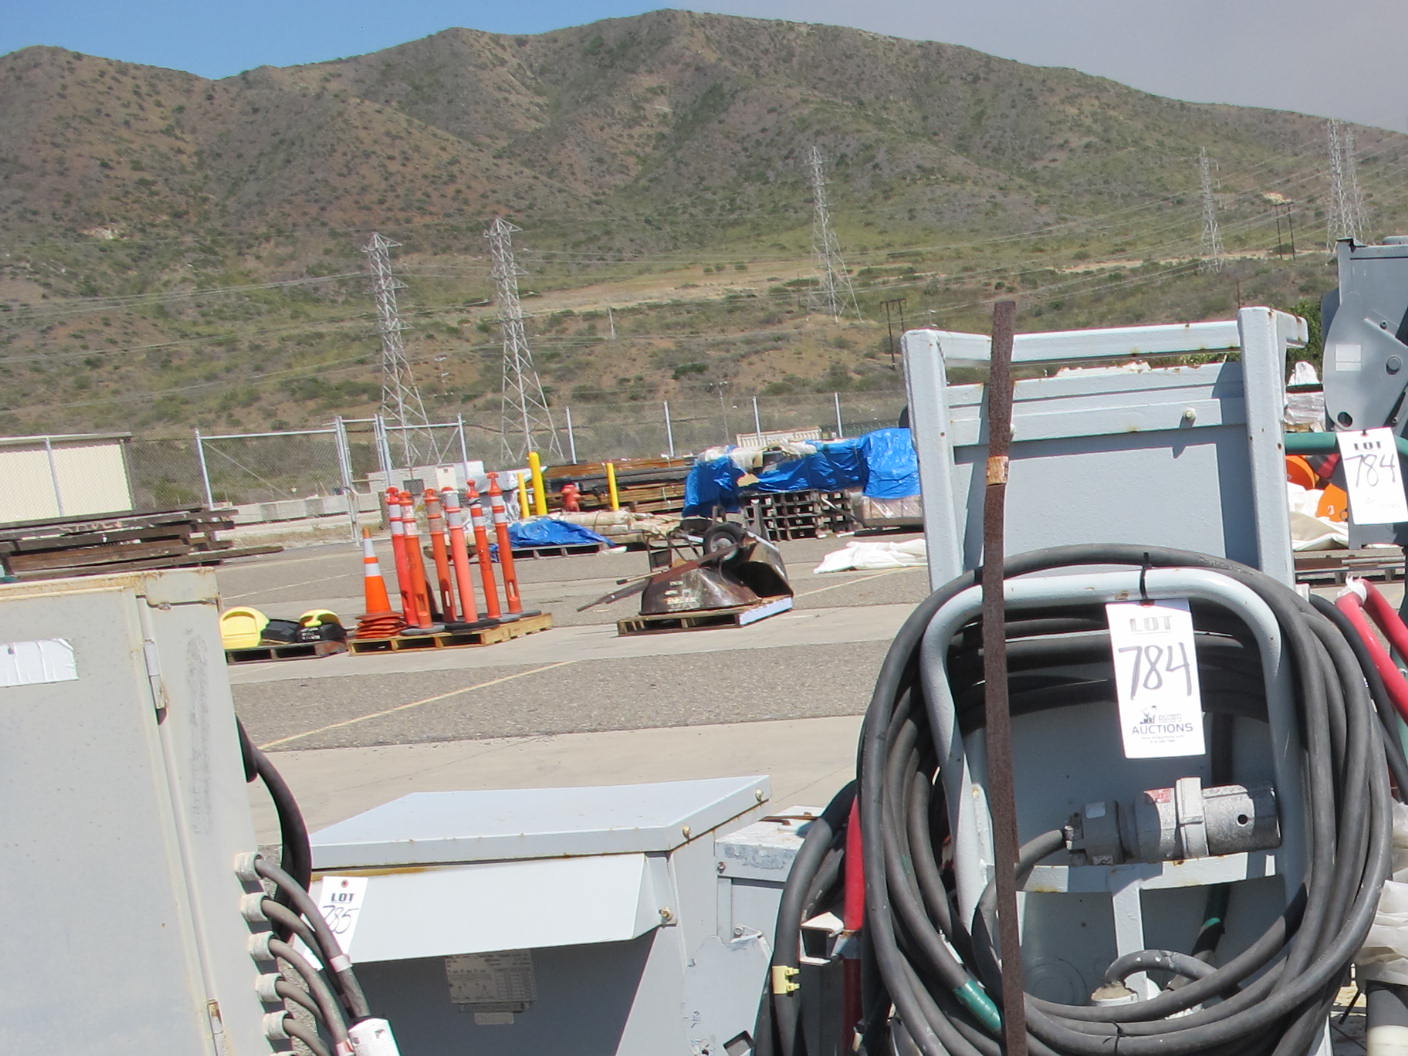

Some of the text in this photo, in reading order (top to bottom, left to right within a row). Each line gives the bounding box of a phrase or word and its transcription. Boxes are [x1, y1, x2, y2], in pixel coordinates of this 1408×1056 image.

[1353, 440, 1382, 451] LOT
[1343, 452, 1397, 489] 784
[1128, 615, 1173, 634] LOT
[1118, 641, 1193, 701] 784
[1131, 722, 1194, 736] AUCTIONS
[330, 892, 355, 902] LOT
[322, 904, 360, 935] 785
